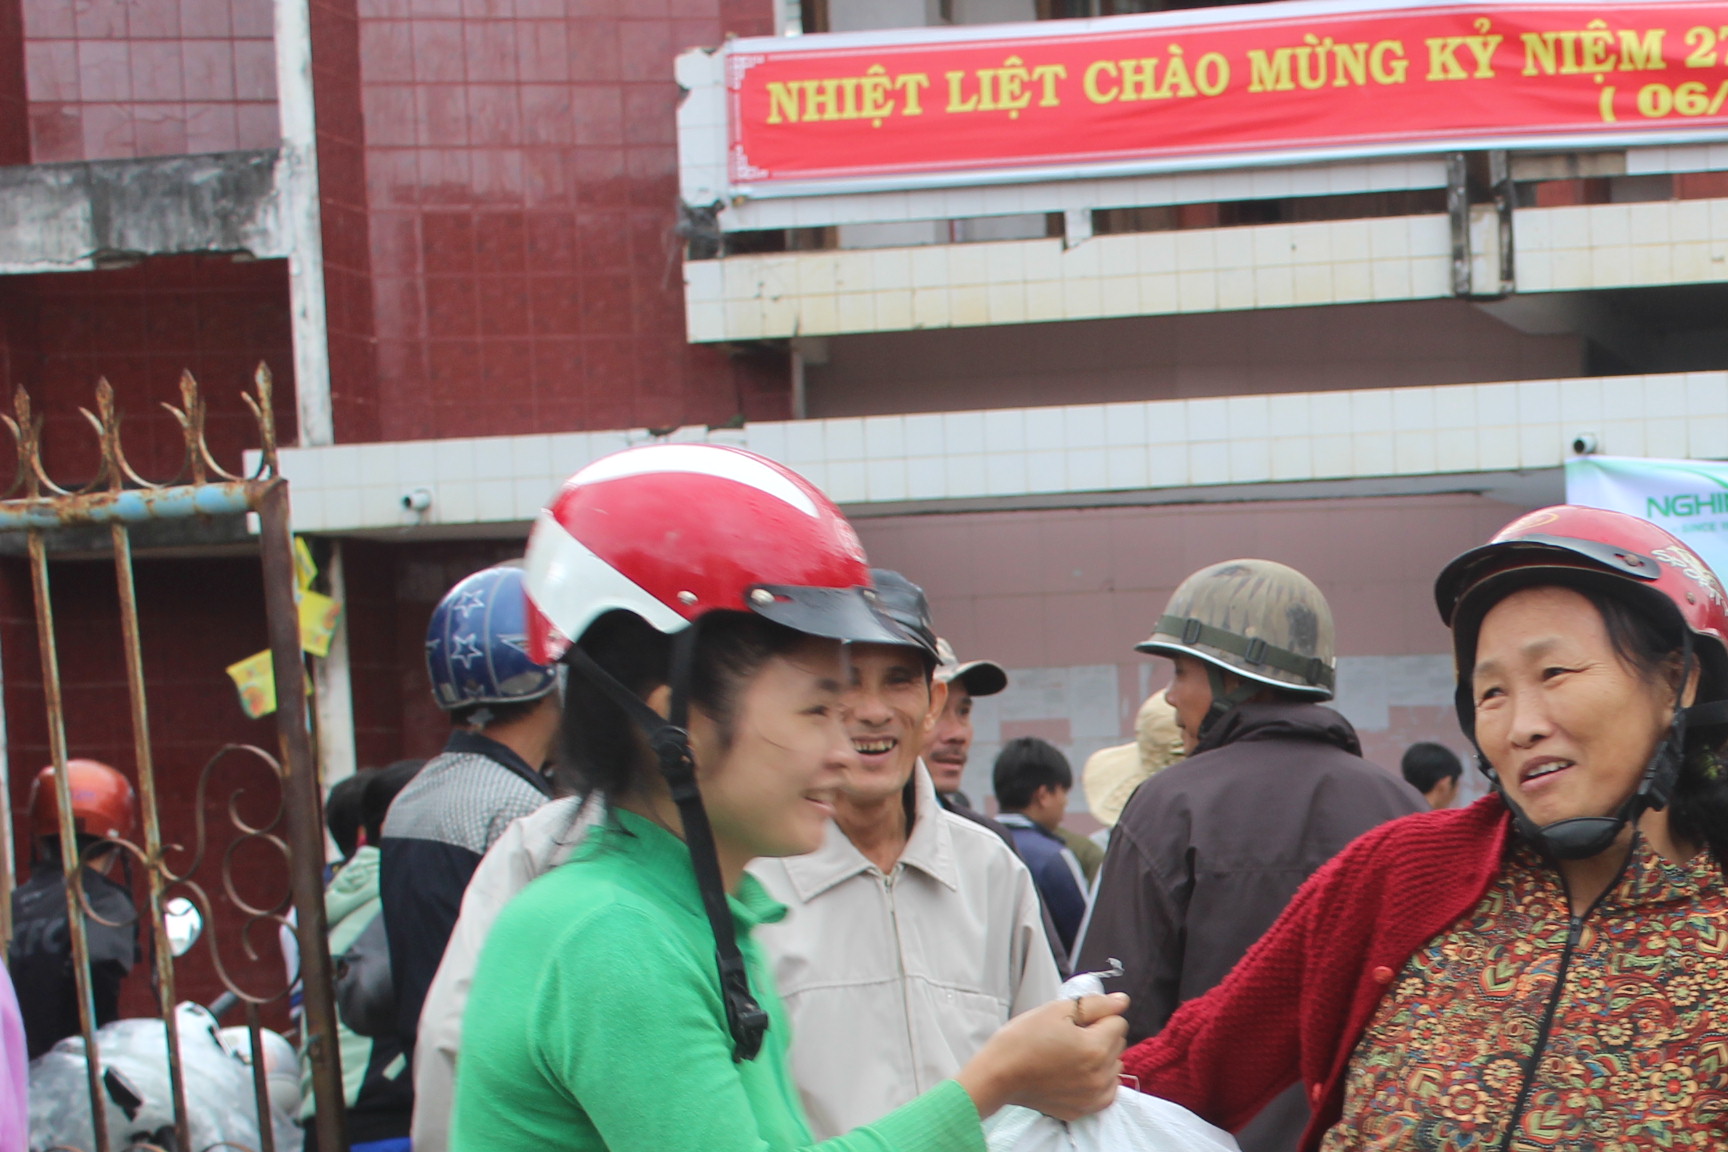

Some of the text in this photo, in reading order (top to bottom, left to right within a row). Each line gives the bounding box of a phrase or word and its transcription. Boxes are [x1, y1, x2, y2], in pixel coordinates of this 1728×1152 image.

[766, 64, 929, 128] NHIỆT
[945, 55, 1067, 119] LIỆT
[1083, 43, 1231, 104] CHÀO
[1246, 33, 1409, 93] MỪNG
[1425, 17, 1503, 81] KỶ
[1520, 18, 1667, 84] NIỆM
